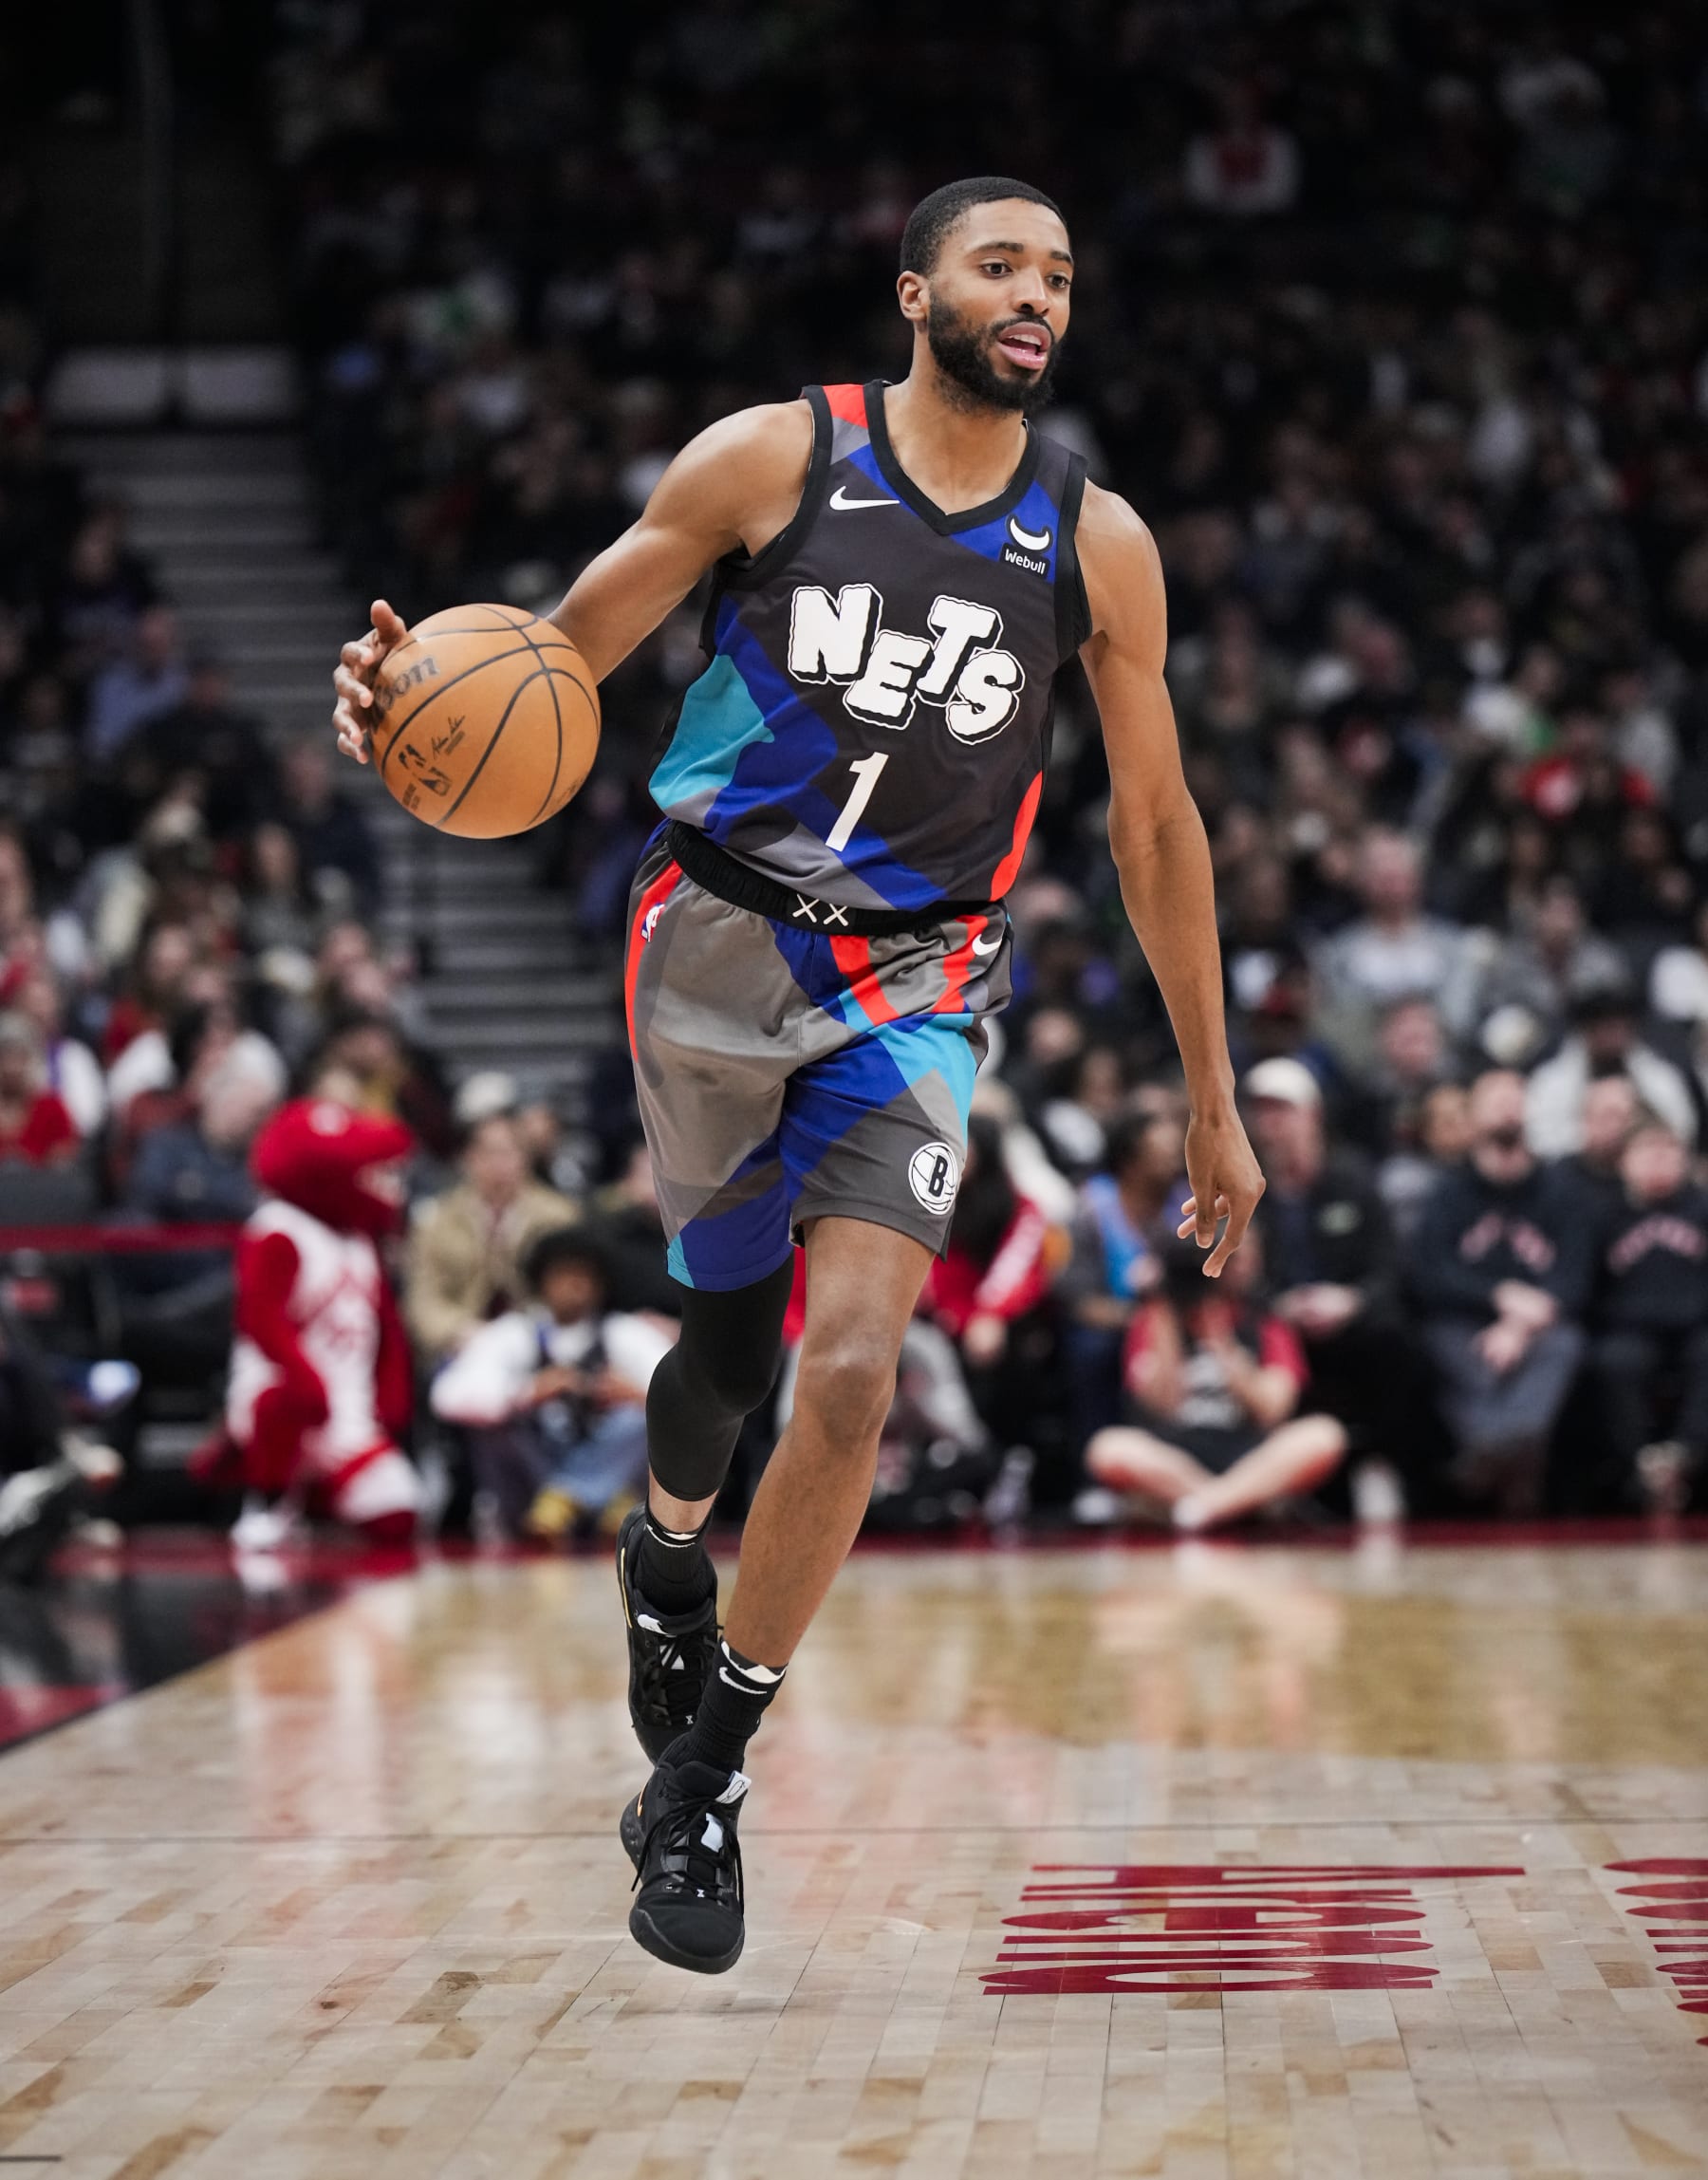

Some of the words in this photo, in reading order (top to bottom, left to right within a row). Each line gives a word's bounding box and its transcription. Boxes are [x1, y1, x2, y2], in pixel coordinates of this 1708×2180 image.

[1005, 549, 1046, 575] Webull
[788, 583, 1026, 745] NETS
[825, 752, 889, 852] 1
[928, 1154, 948, 1198] B
[978, 1865, 1525, 1995] Arena
